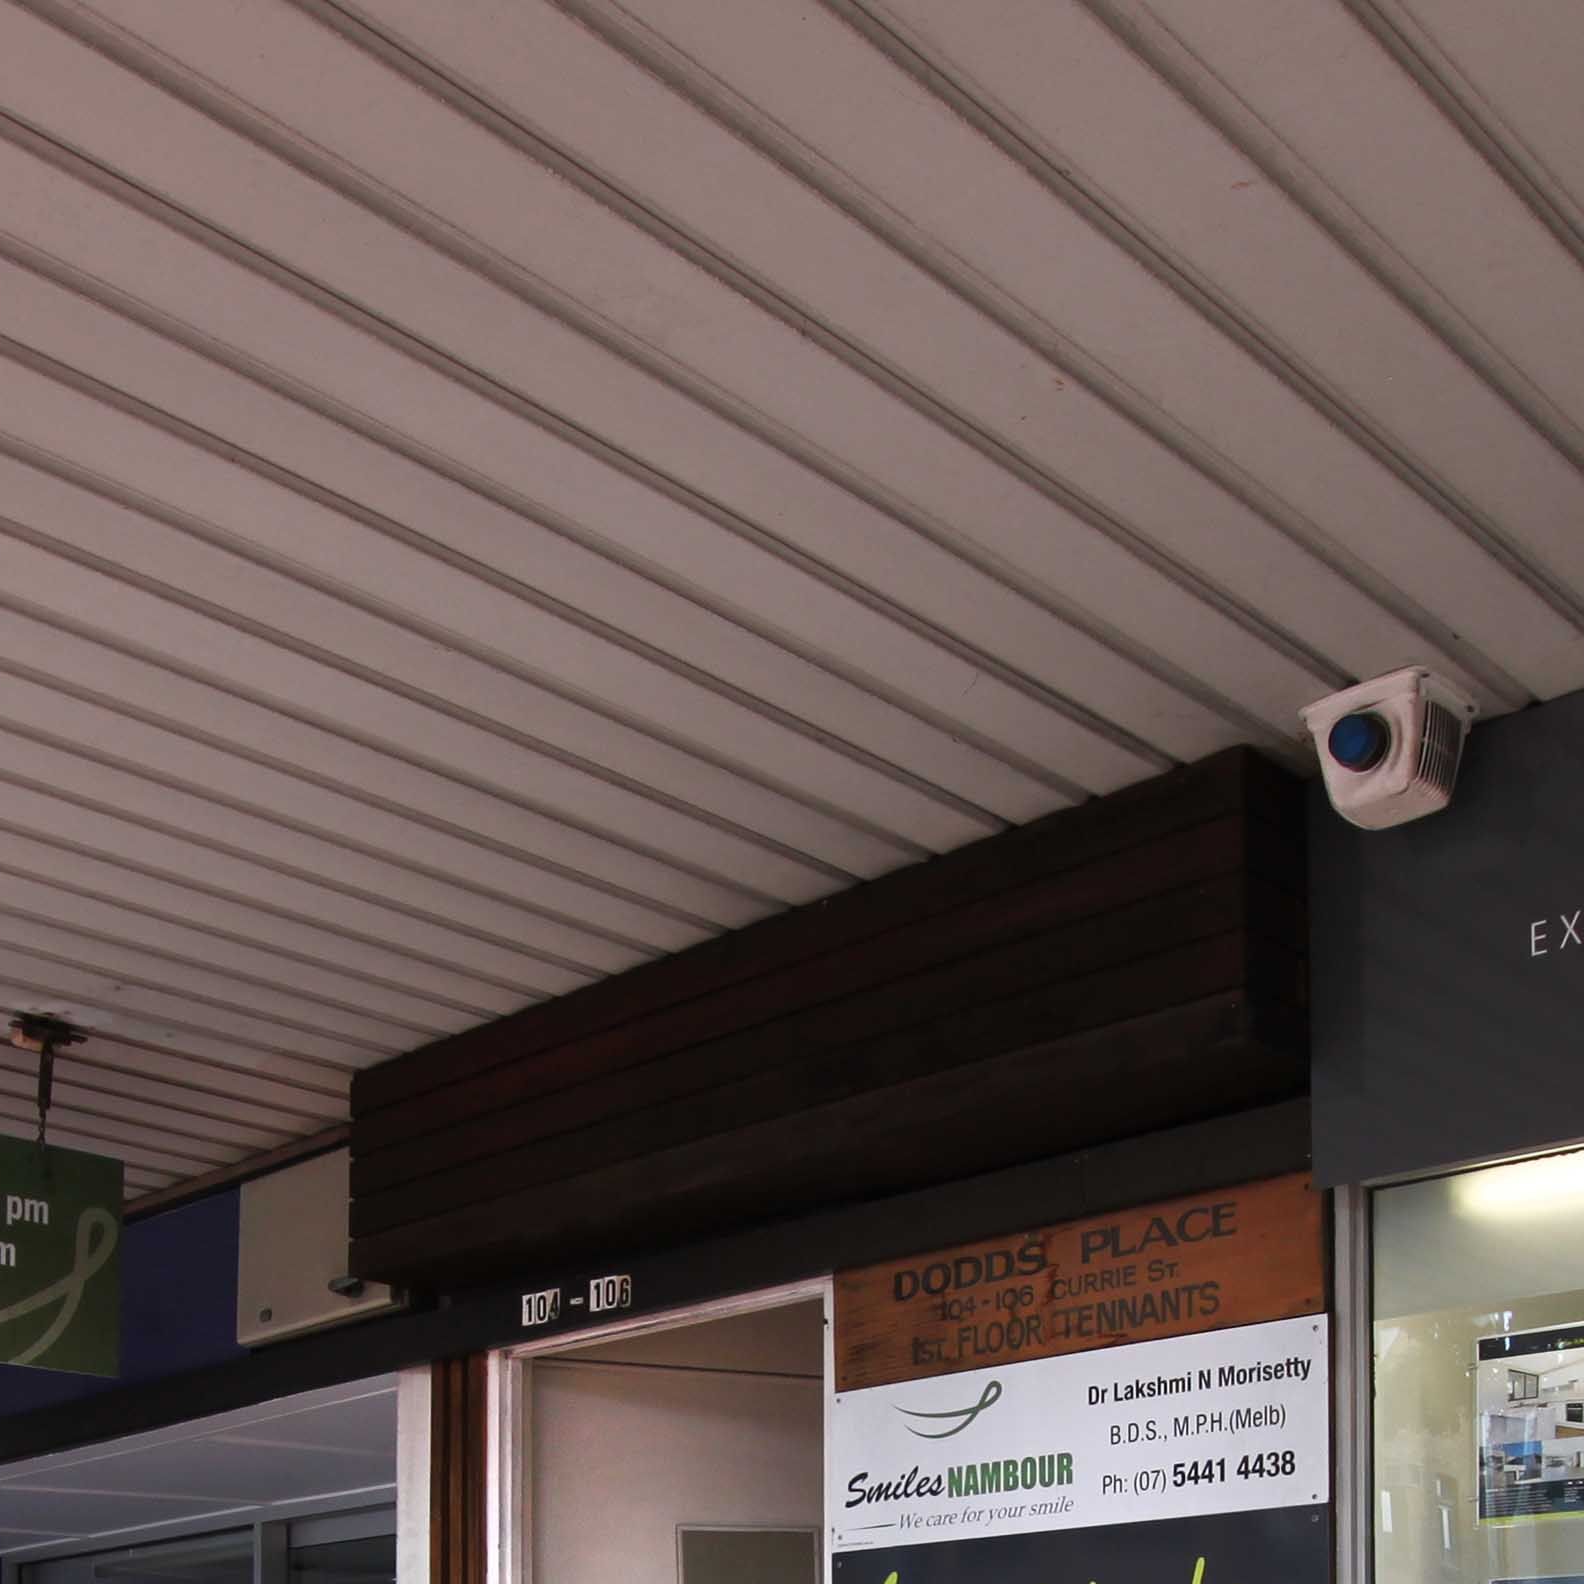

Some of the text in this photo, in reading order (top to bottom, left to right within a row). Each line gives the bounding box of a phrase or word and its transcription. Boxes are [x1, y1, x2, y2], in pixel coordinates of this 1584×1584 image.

[6, 1188, 50, 1226] pm
[1081, 1202, 1238, 1264] PLACE
[522, 1288, 560, 1326] 104
[590, 1275, 632, 1312] 106
[1053, 1265, 1136, 1299] CURRIE
[957, 1315, 1044, 1361] FLOOR
[1052, 1282, 1221, 1340] TENNANTS
[1088, 1356, 1312, 1406] Dr Lakshmi N Morisetty
[1110, 1404, 1287, 1445] B.D.S., M.P.H.(Melb)
[845, 1453, 1074, 1508] Smiles NAMBOUR
[1102, 1450, 1296, 1496] Ph: (07) 5441 4438
[898, 1496, 1074, 1529] We care for your smile
